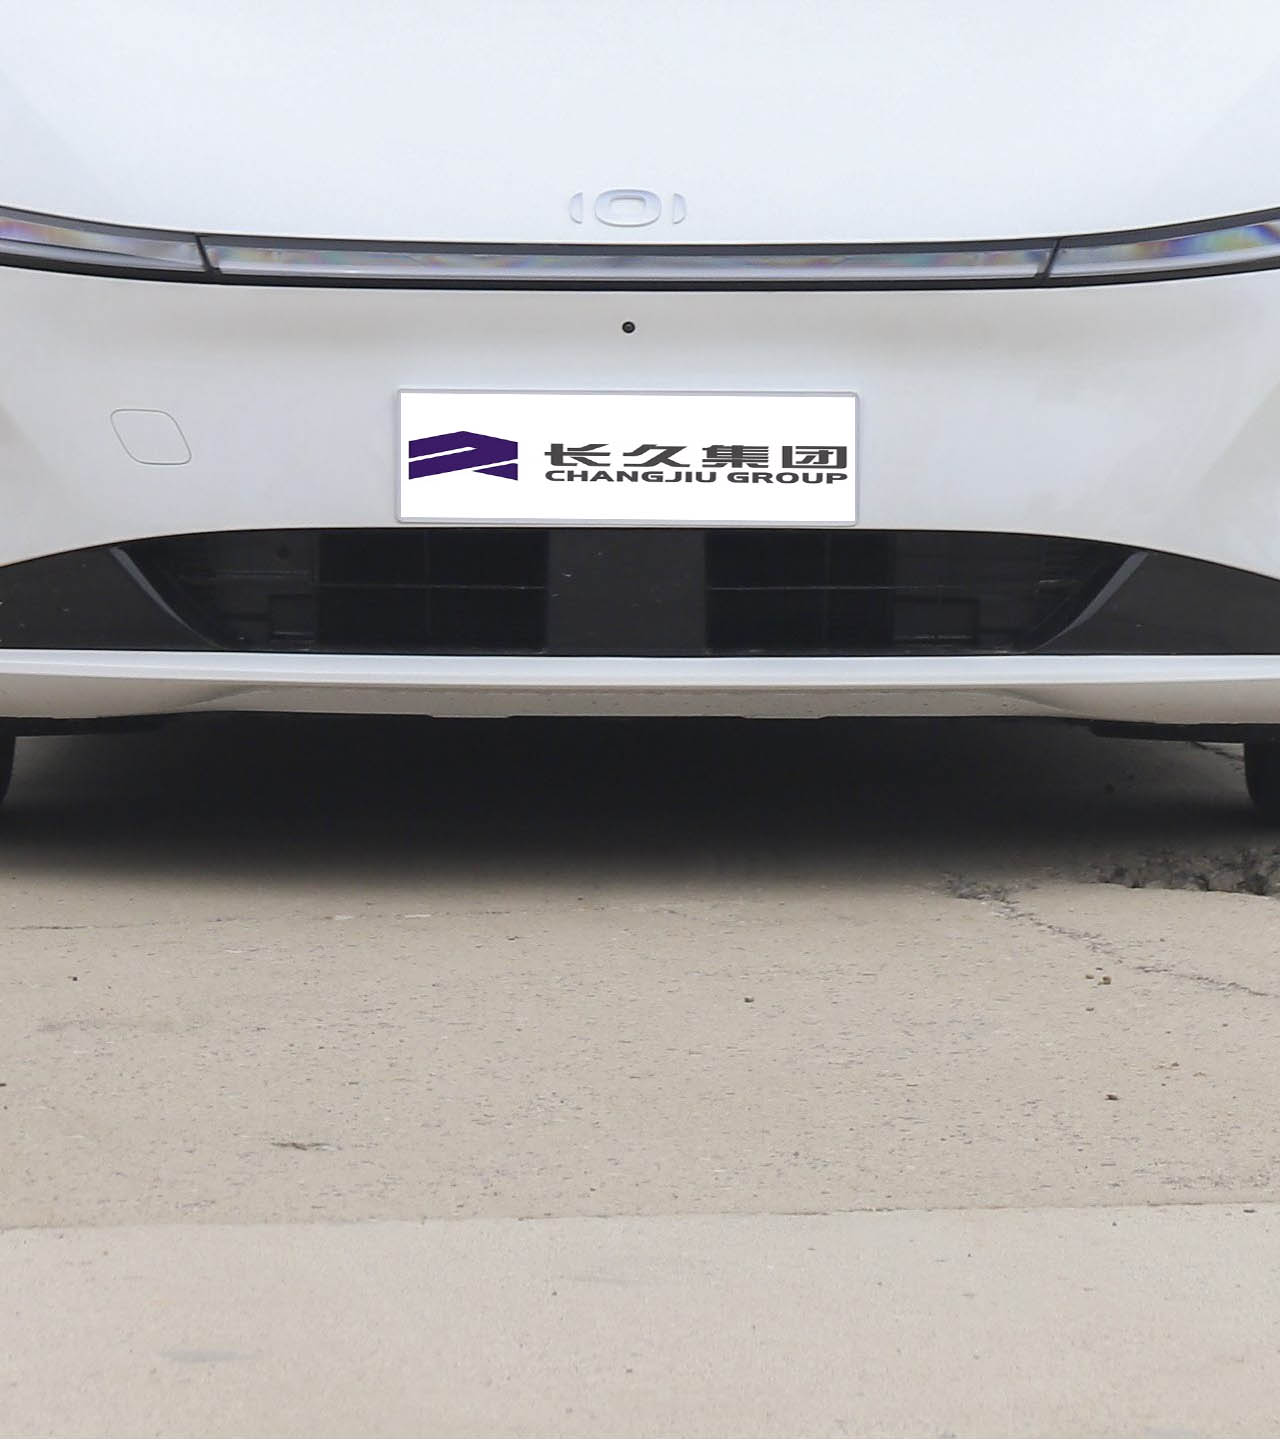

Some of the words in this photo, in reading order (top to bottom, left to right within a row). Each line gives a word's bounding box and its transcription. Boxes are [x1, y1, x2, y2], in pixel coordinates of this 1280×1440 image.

[544, 443, 848, 469] 长久集团
[544, 470, 717, 484] CHANGJIU
[726, 471, 848, 485] GROUP
